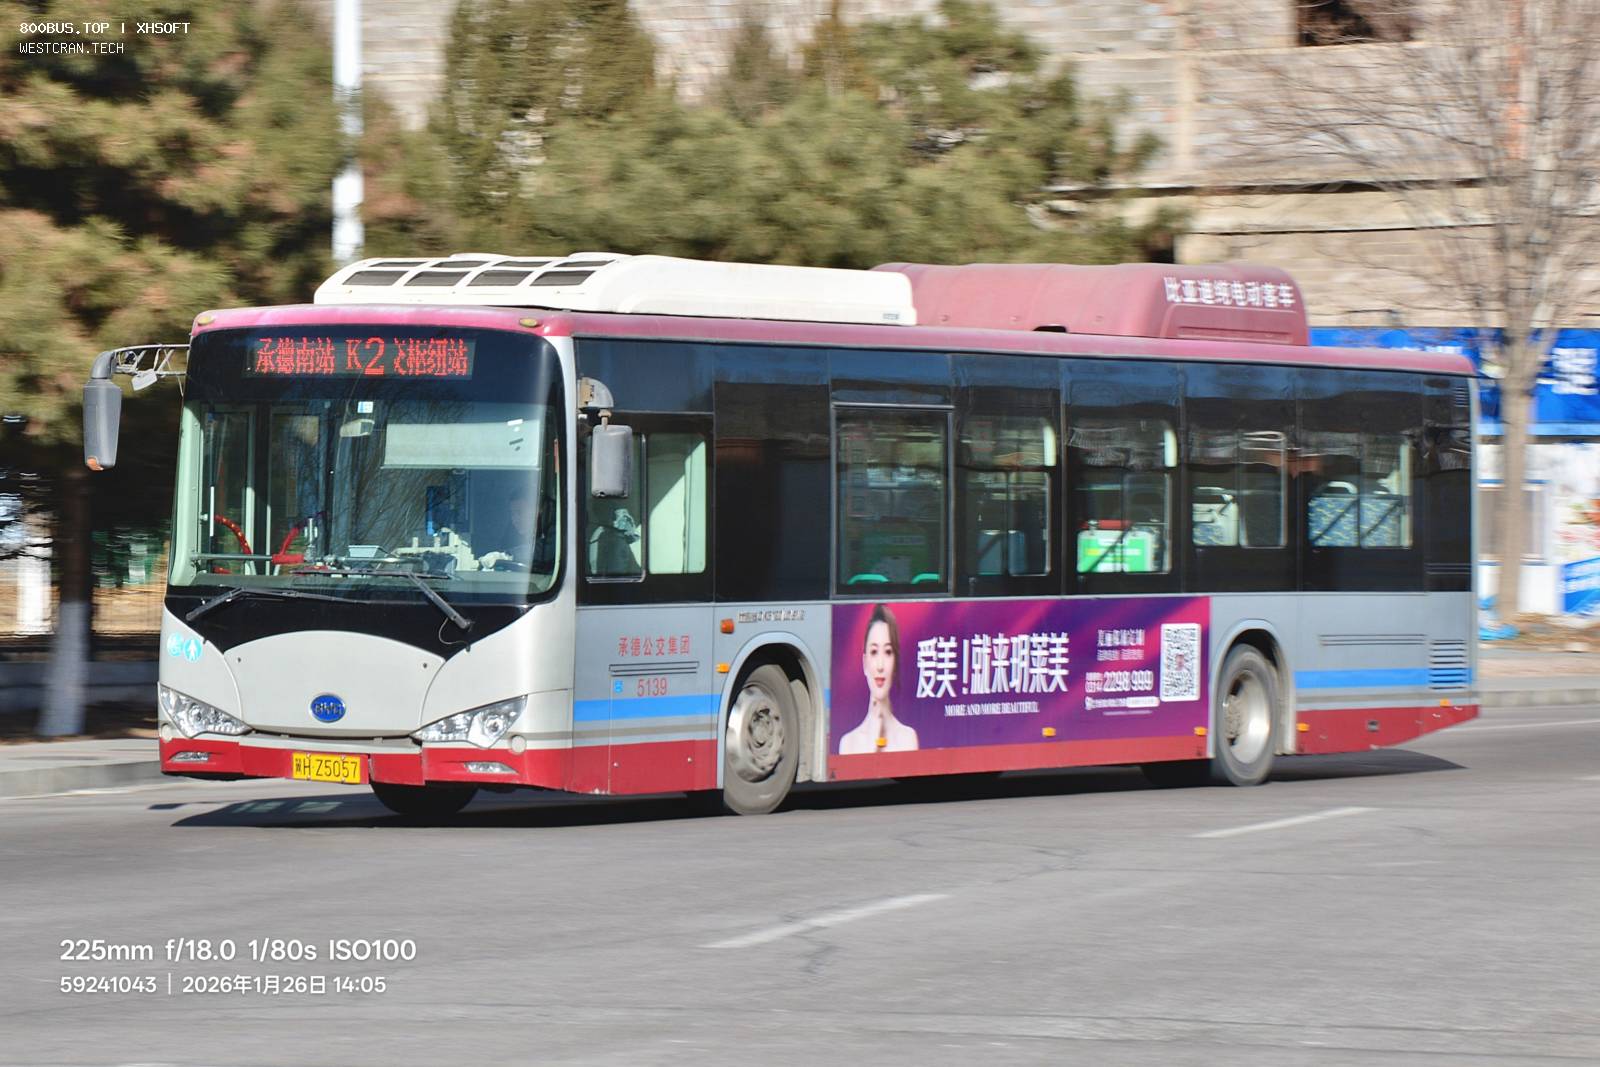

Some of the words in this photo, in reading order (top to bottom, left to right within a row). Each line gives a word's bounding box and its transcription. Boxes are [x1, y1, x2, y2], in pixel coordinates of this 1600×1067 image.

[254, 336, 336, 375] 承德南站
[344, 337, 385, 375] K2
[618, 634, 691, 657] 承德公交集团
[637, 677, 668, 698] 5139
[944, 704, 966, 717] MORE
[966, 703, 981, 716] AND
[981, 702, 1001, 716] MORE
